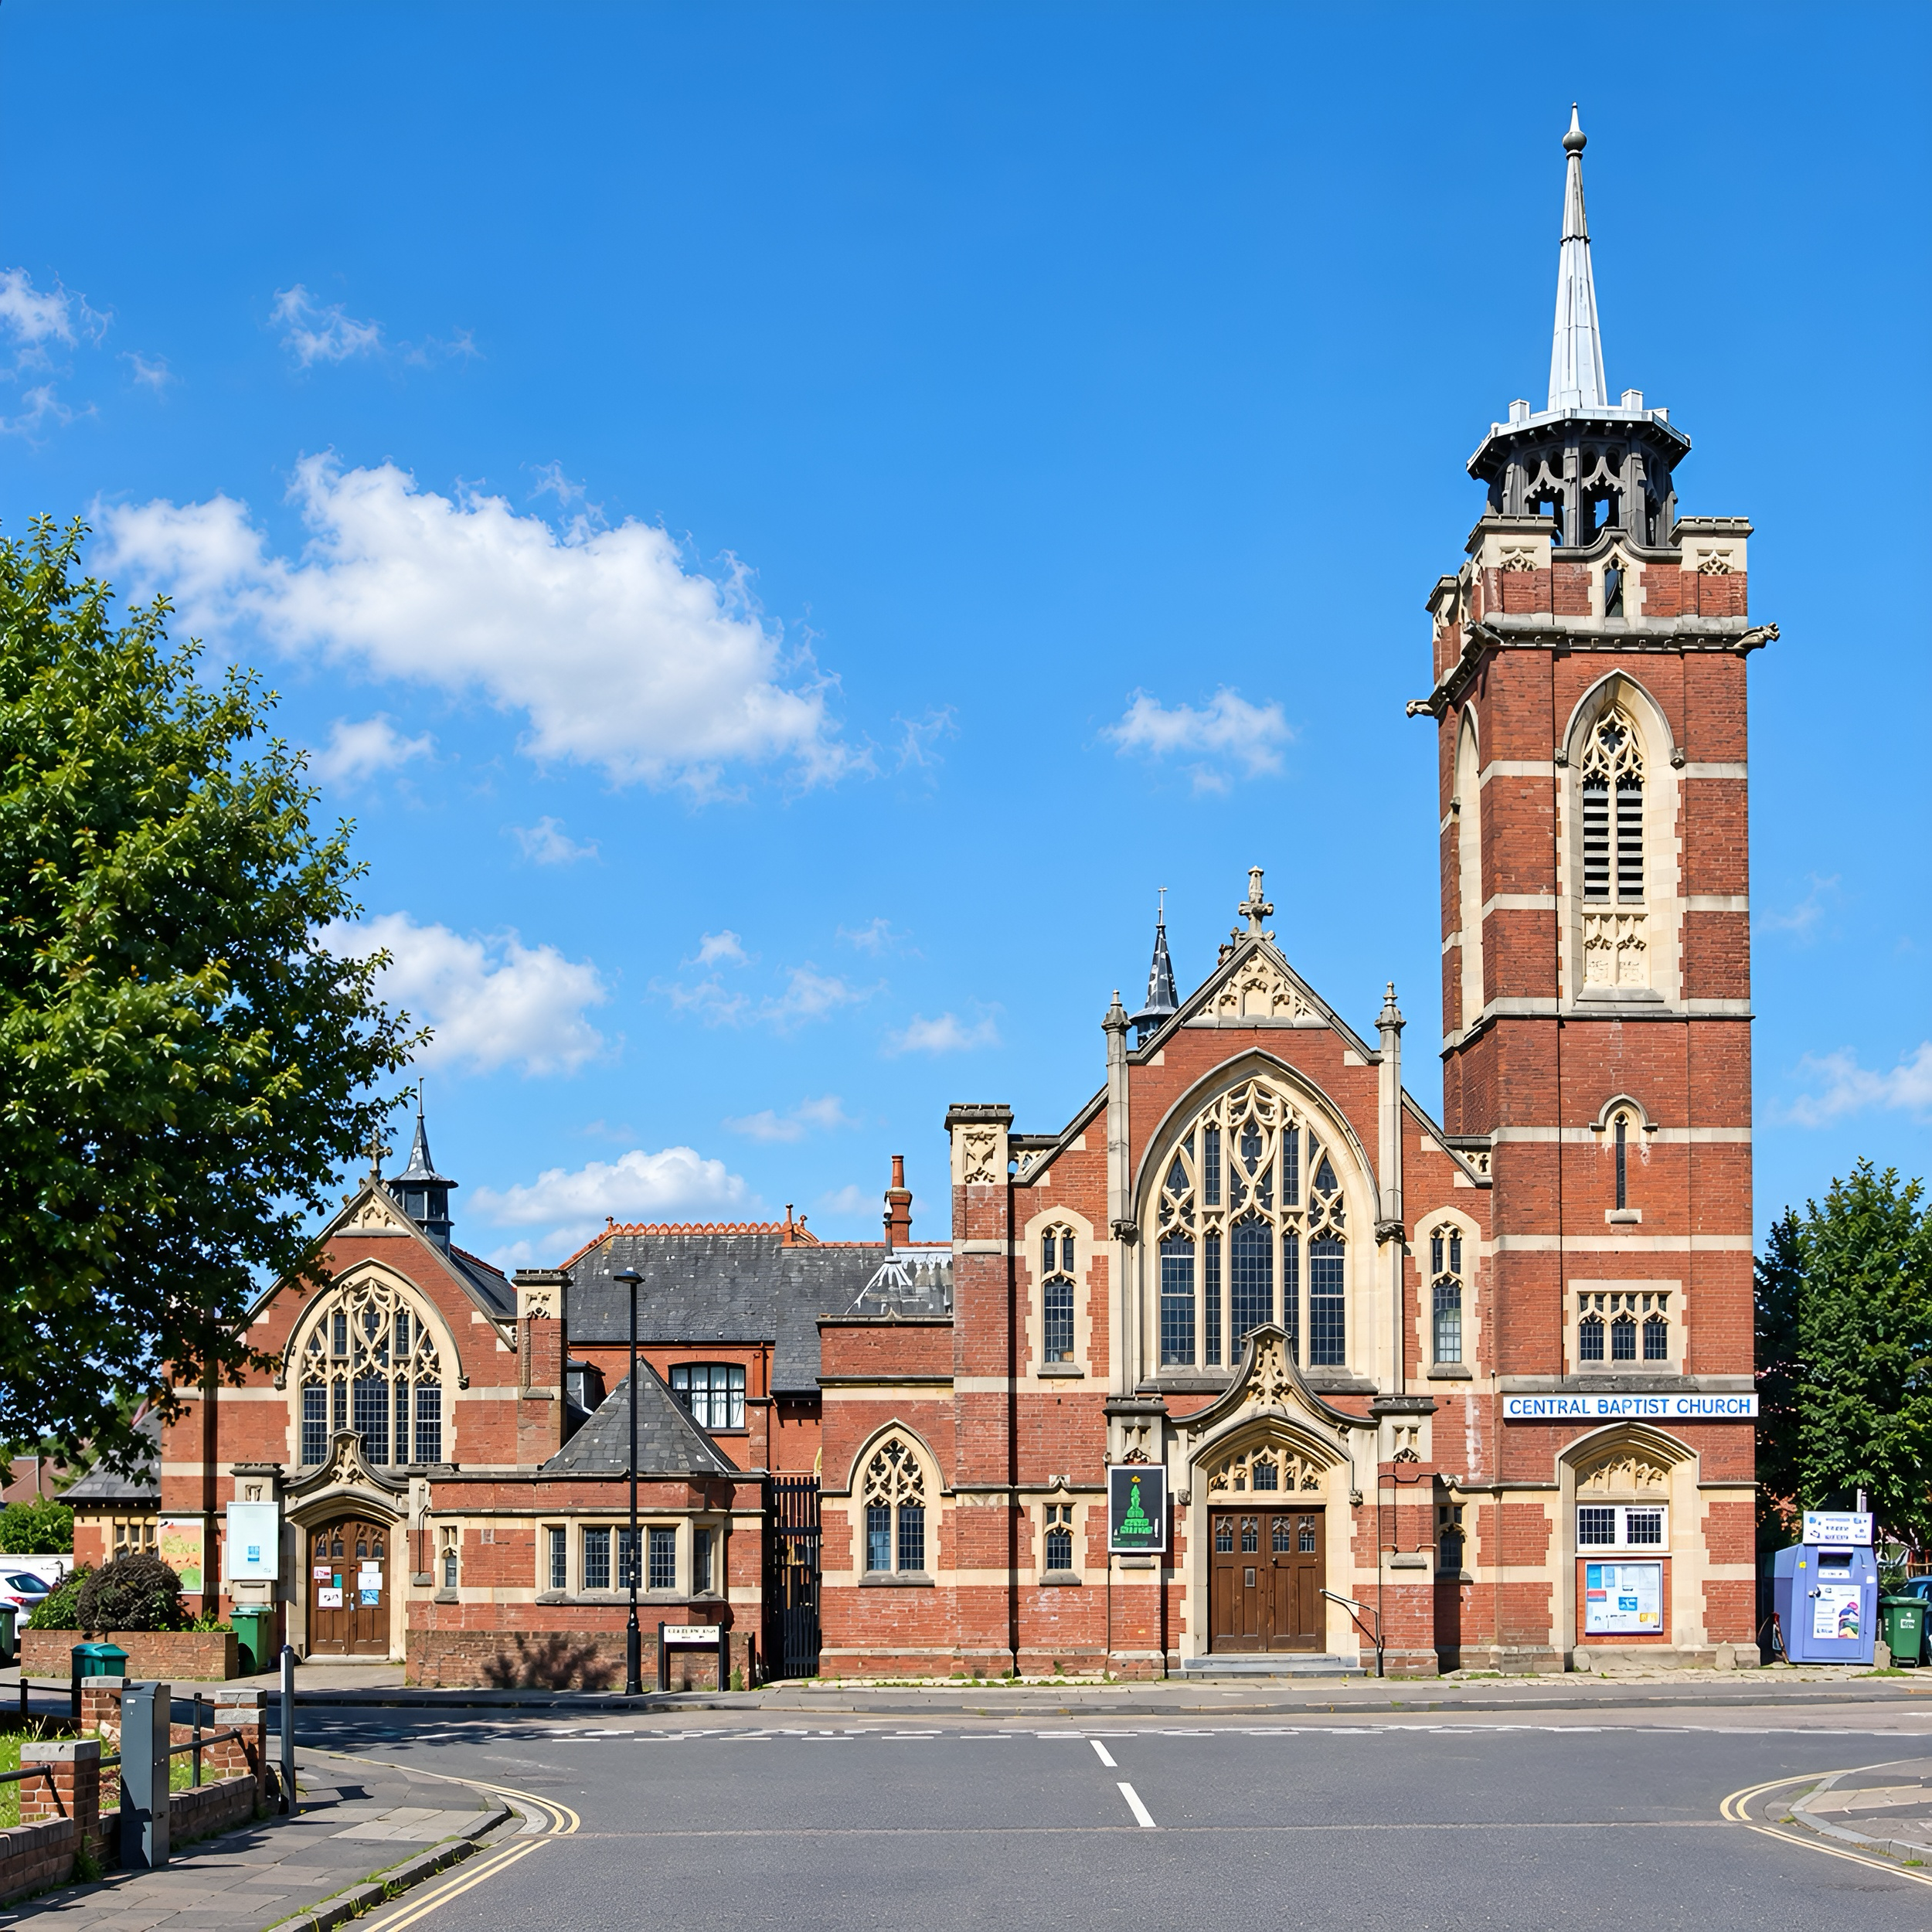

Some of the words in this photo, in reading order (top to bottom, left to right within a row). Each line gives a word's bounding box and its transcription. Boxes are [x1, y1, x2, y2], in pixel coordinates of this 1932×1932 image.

[1509, 1399, 1591, 1415] CENTRAL
[1597, 1399, 1670, 1414] BAPTIST
[1676, 1398, 1750, 1414] CHURCH
